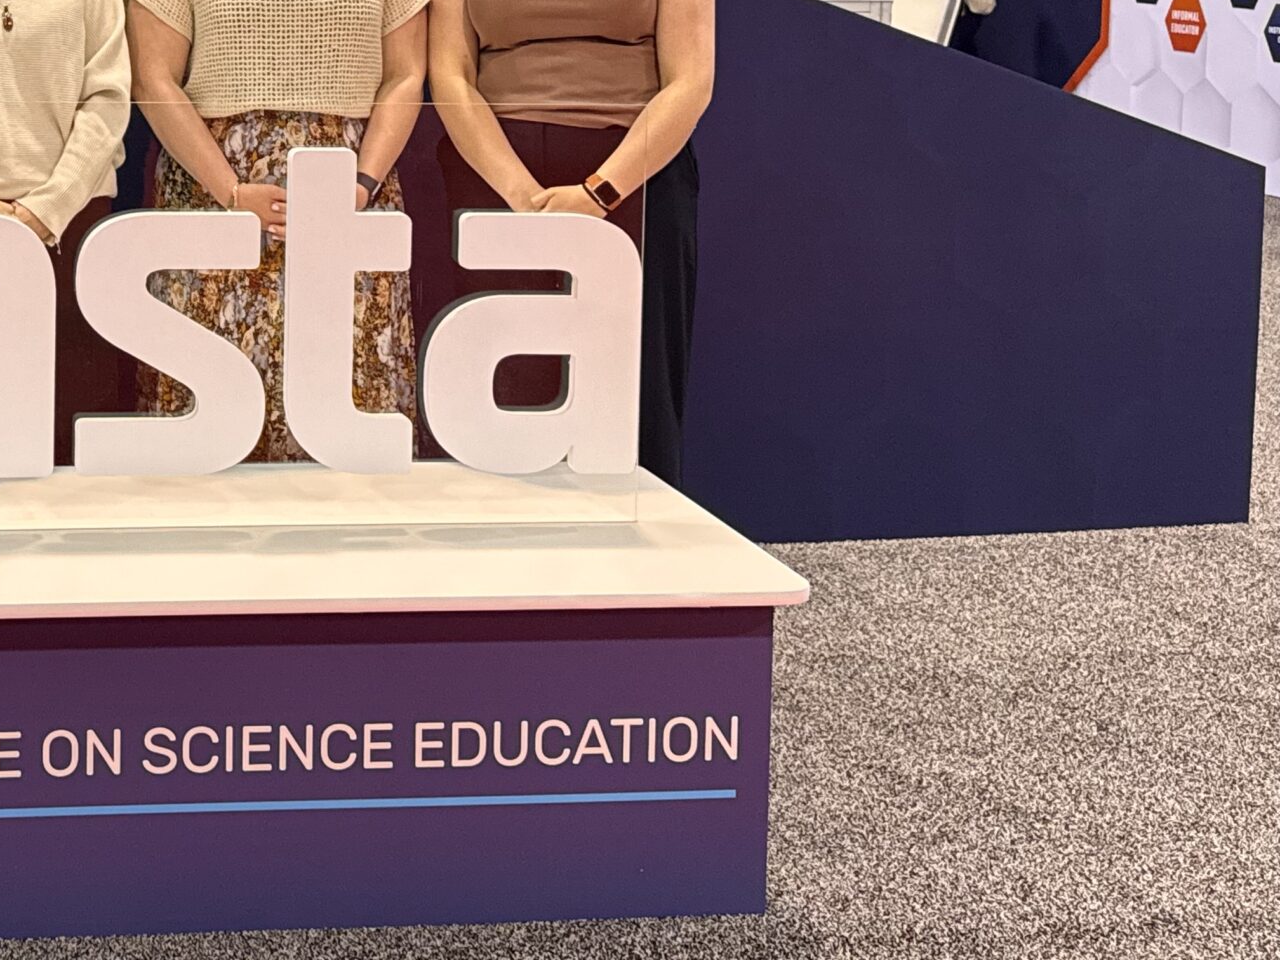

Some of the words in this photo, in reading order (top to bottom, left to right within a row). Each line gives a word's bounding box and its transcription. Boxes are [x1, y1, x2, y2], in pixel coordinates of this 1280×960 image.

[1171, 9, 1200, 23] INFORMAL
[1170, 22, 1200, 35] EDUCATOR
[41, 728, 122, 778] ON
[141, 722, 394, 775] SCIENCE
[414, 715, 739, 768] EDUCATION
